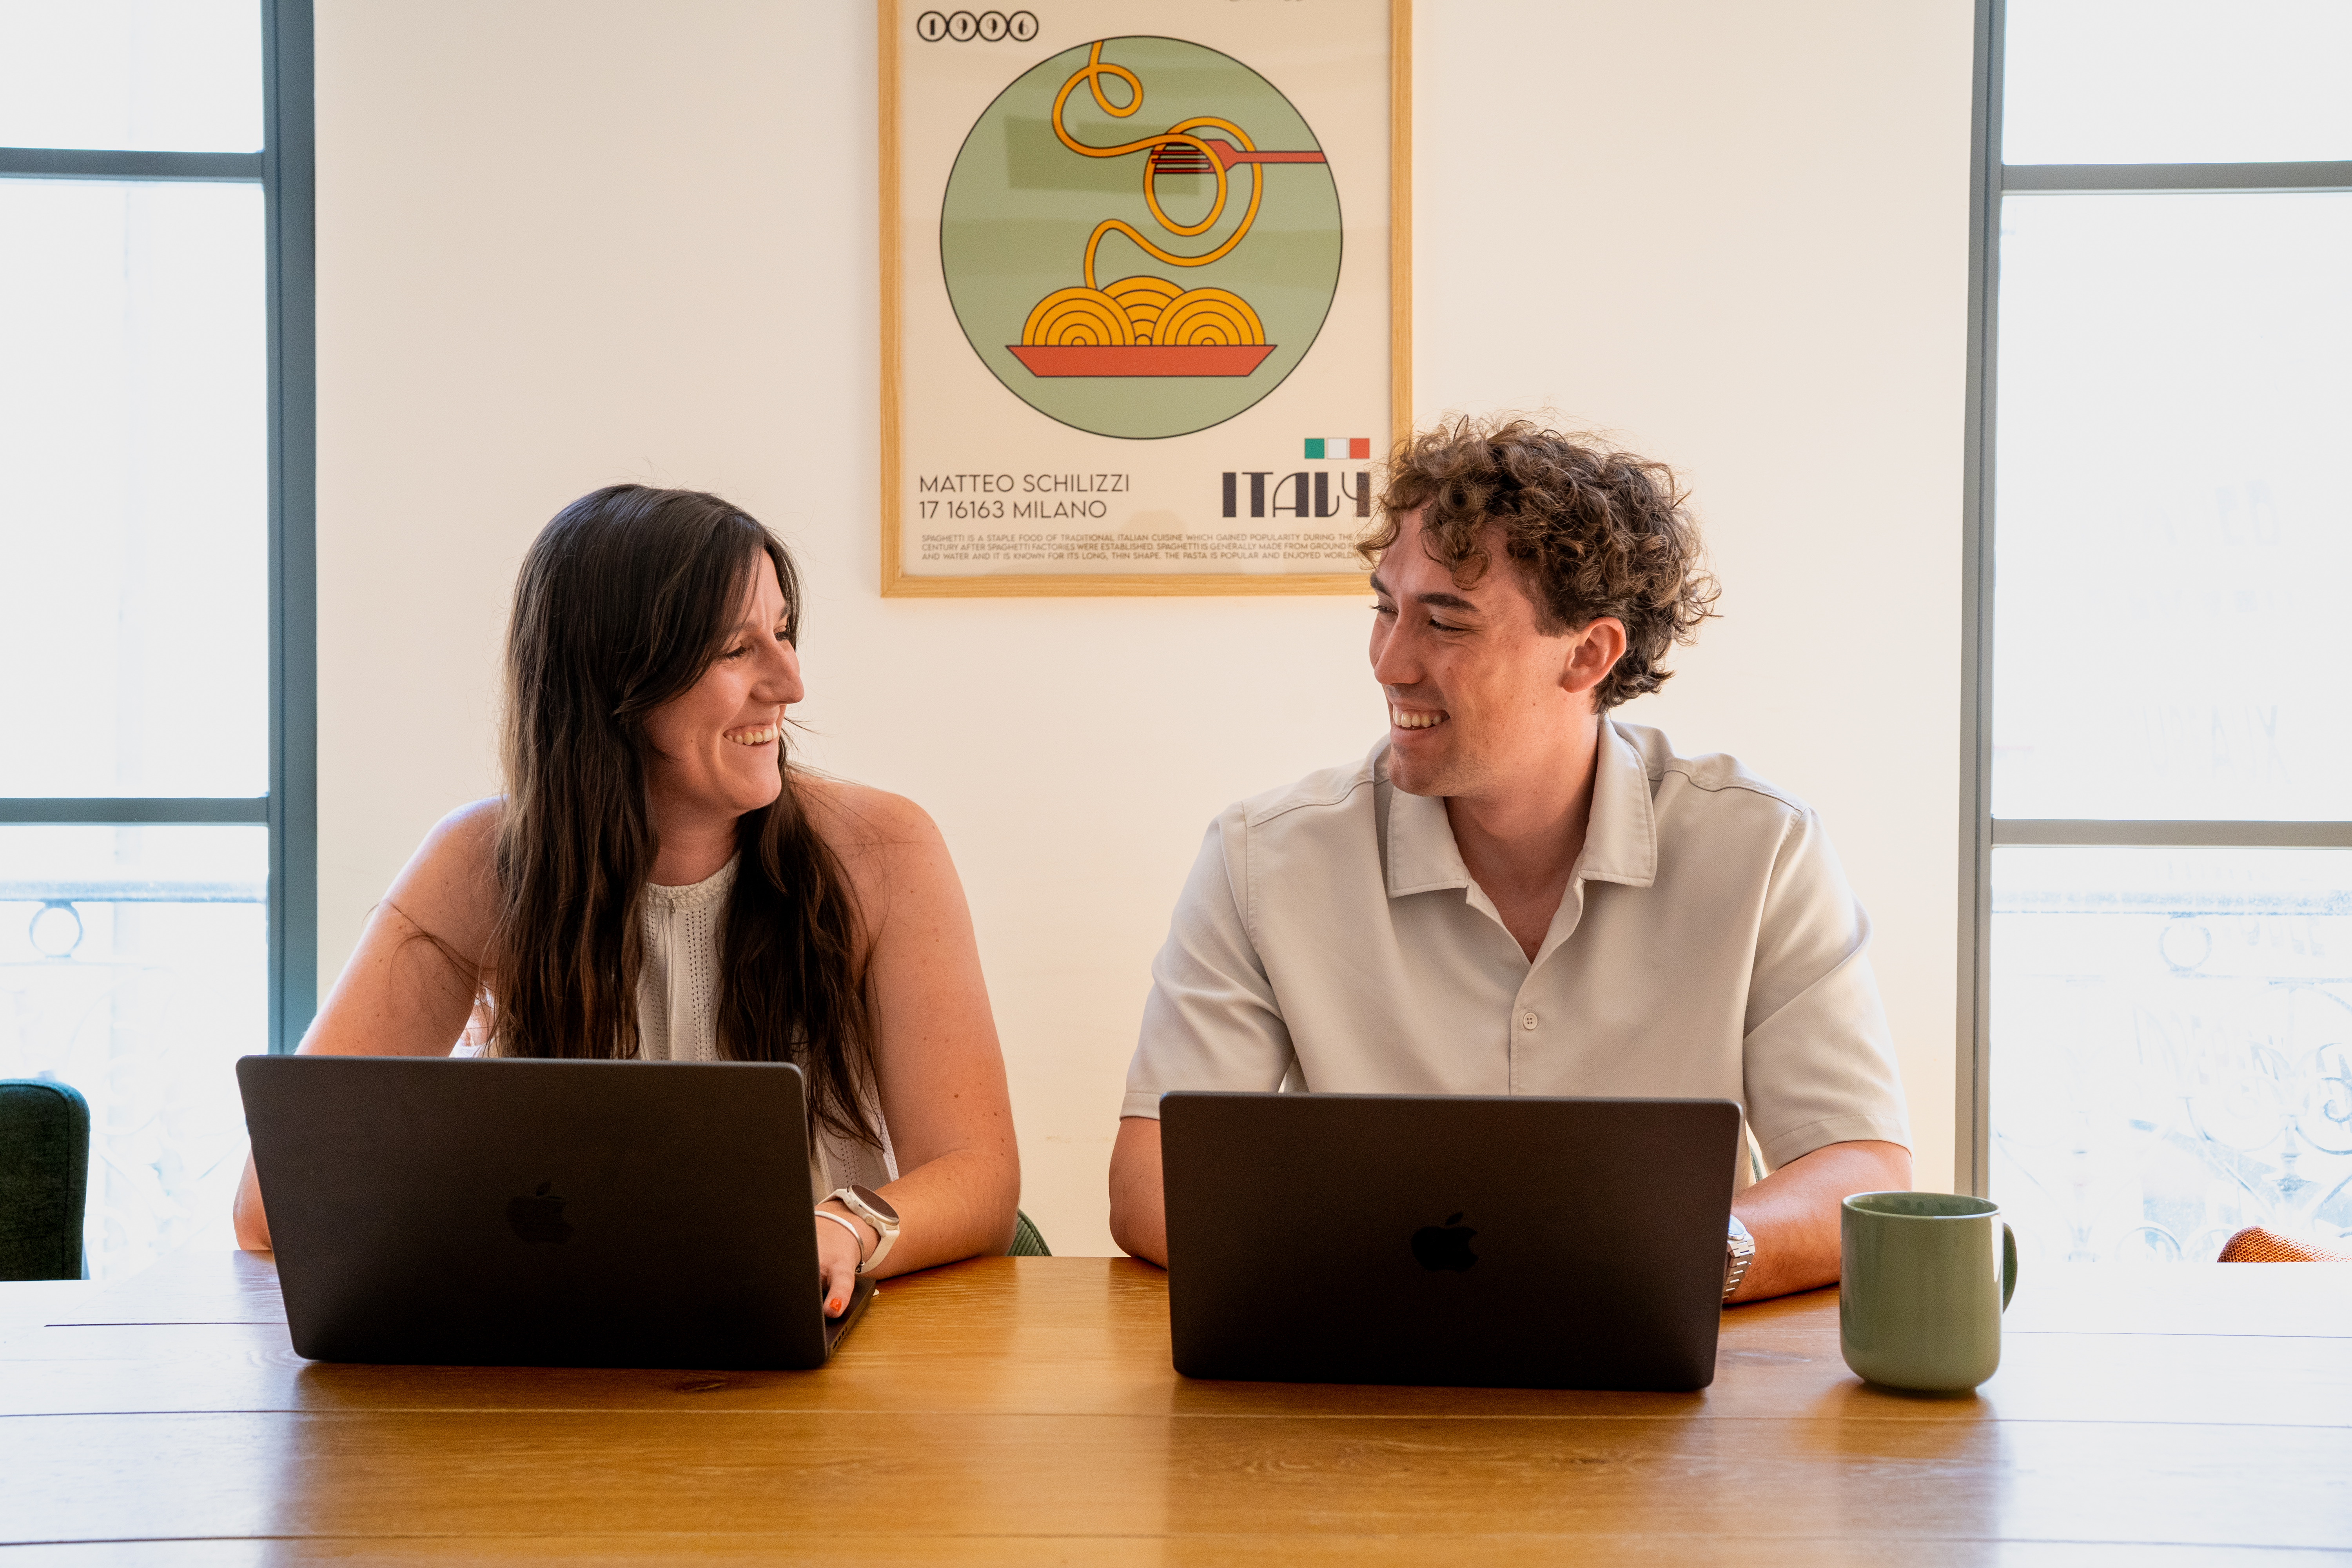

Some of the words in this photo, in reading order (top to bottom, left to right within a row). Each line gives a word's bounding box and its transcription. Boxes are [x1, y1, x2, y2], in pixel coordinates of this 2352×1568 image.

[918, 12, 1038, 40] 1996
[920, 474, 1014, 492] MATTEO
[1023, 474, 1129, 492] SCHILIZZI
[1222, 472, 1370, 517] ITALY
[919, 500, 939, 519] 17
[947, 500, 1004, 519] 16163
[1013, 500, 1107, 519] MILANO
[922, 534, 965, 542] SPAGHETTI
[967, 534, 975, 542] IS
[977, 534, 984, 542] A
[986, 534, 1016, 542] STAPLE
[1019, 534, 1043, 542] FOOD
[1045, 534, 1057, 542] OF
[1061, 534, 1114, 542] TRADITIONAL
[1118, 534, 1149, 542] ITALIAN
[1151, 534, 1183, 542] CUISINE
[1186, 534, 1213, 542] WHICH
[1216, 534, 1247, 542] GAINED
[1250, 534, 1300, 542] POPULARITY
[1303, 534, 1335, 542] DURING
[1339, 534, 1352, 542] THE
[922, 543, 958, 551] CENTURY
[960, 543, 985, 551] AFTER
[987, 543, 1031, 551] SPAGHETTI
[1032, 543, 1075, 551] FACTORIES
[1077, 543, 1098, 551] WERE
[1156, 543, 1200, 551] SPAGHETTI
[1201, 543, 1209, 551] IS
[1209, 543, 1257, 551] GENERALLY
[1258, 543, 1283, 551] MADE
[1284, 543, 1308, 551] FROM
[1310, 543, 1346, 551] GROUND
[922, 552, 940, 560] AND
[943, 552, 969, 560] WATER
[972, 552, 991, 560] AND
[993, 552, 1000, 560] IT
[1003, 552, 1011, 560] IS
[1013, 552, 1045, 560] KNOWN
[1047, 552, 1065, 560] FOR
[1067, 552, 1079, 560] ITS
[1112, 552, 1131, 560] THIN
[1165, 552, 1179, 560] THE
[1182, 552, 1207, 560] PASTA
[1210, 552, 1217, 560] IS
[1220, 552, 1259, 560] POPULAR
[1262, 552, 1280, 560] AND
[1283, 552, 1321, 560] ENJOYED
